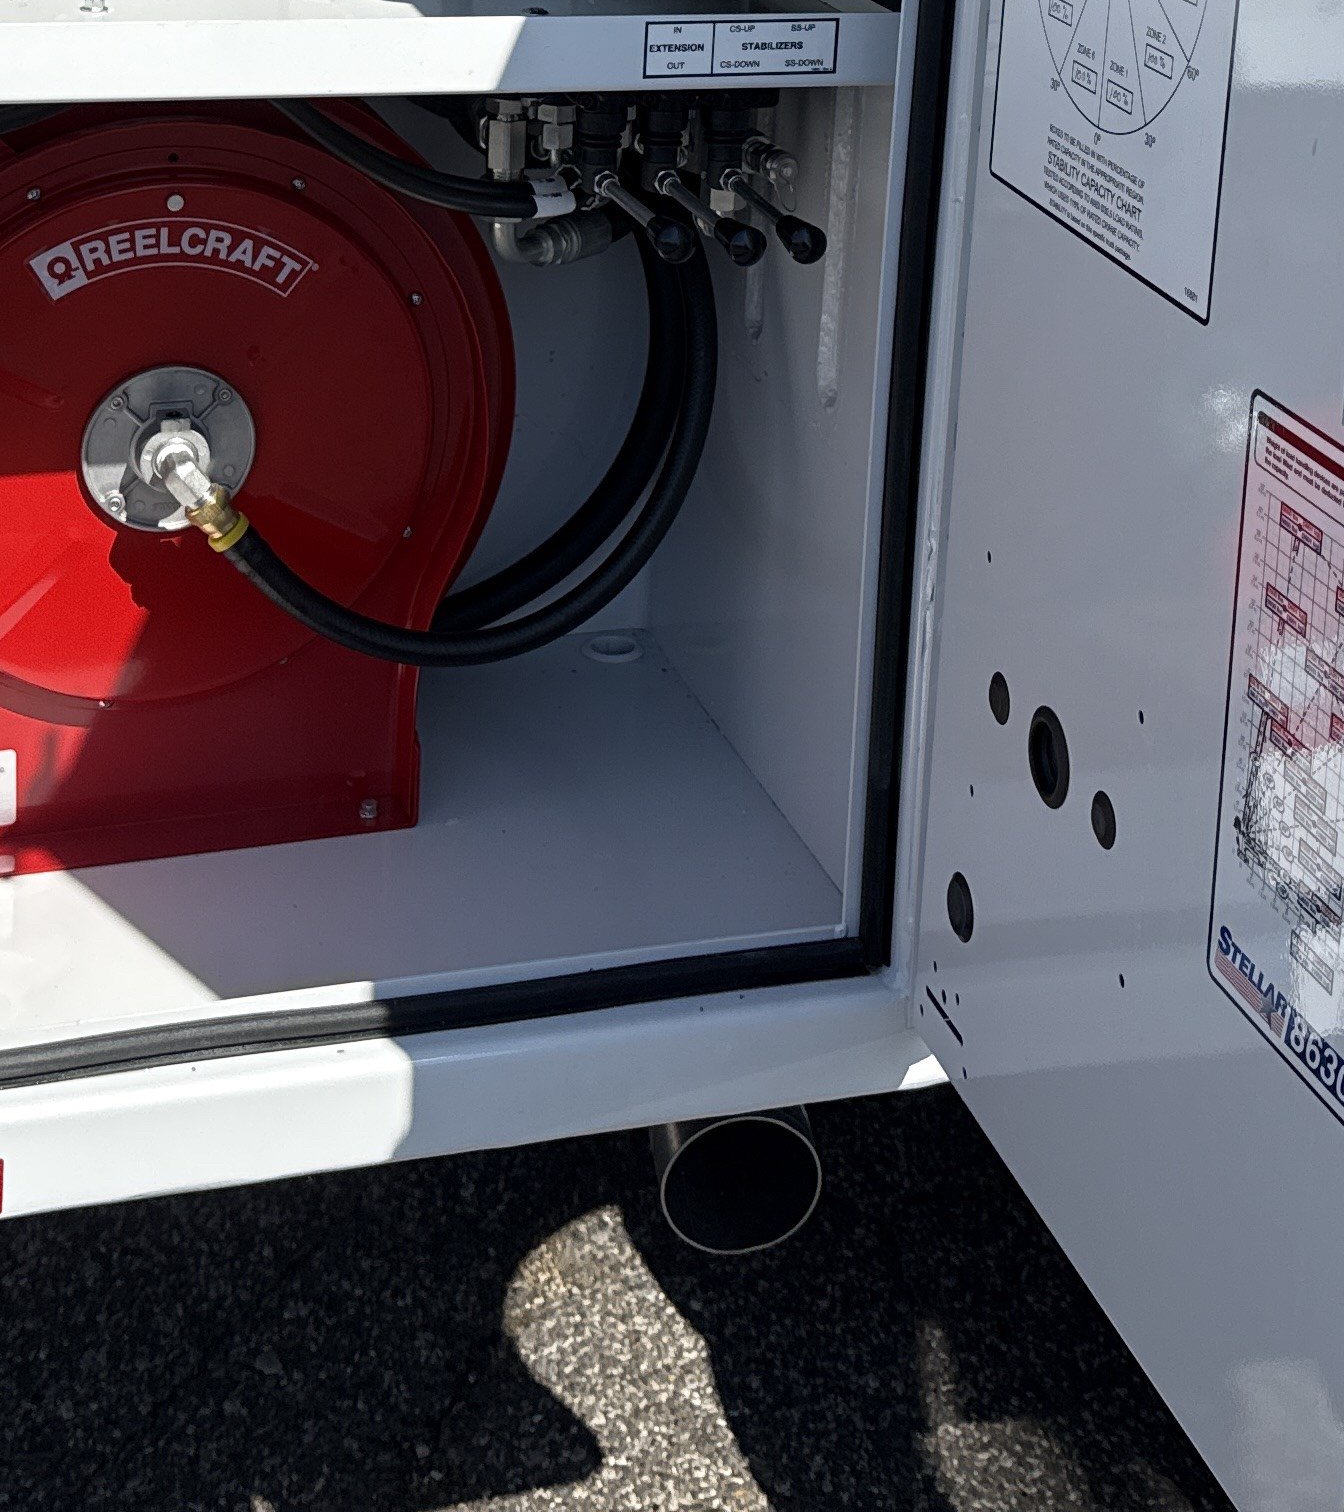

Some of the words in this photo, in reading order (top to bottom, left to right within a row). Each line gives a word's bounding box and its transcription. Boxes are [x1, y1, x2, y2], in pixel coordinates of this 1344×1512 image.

[673, 26, 682, 34] IN
[729, 24, 756, 33] CS-UP
[791, 23, 816, 32] SS-UP
[1146, 26, 1162, 42] ZONE
[1162, 34, 1167, 44] 2
[649, 43, 704, 53] EXTENSION
[741, 41, 804, 51] STABILIZERS
[1077, 43, 1091, 58] ZONE
[667, 61, 685, 70] OUT
[720, 60, 760, 69] CS-DOWN
[784, 58, 824, 67] SS-DOWN
[1109, 60, 1125, 77] ZONE
[1047, 150, 1080, 181] STABILITY
[1080, 172, 1116, 205] CAPACITY
[1116, 195, 1143, 223] CHART
[79, 227, 303, 285] REELCRAFT
[1218, 925, 1288, 1019] STELLAR
